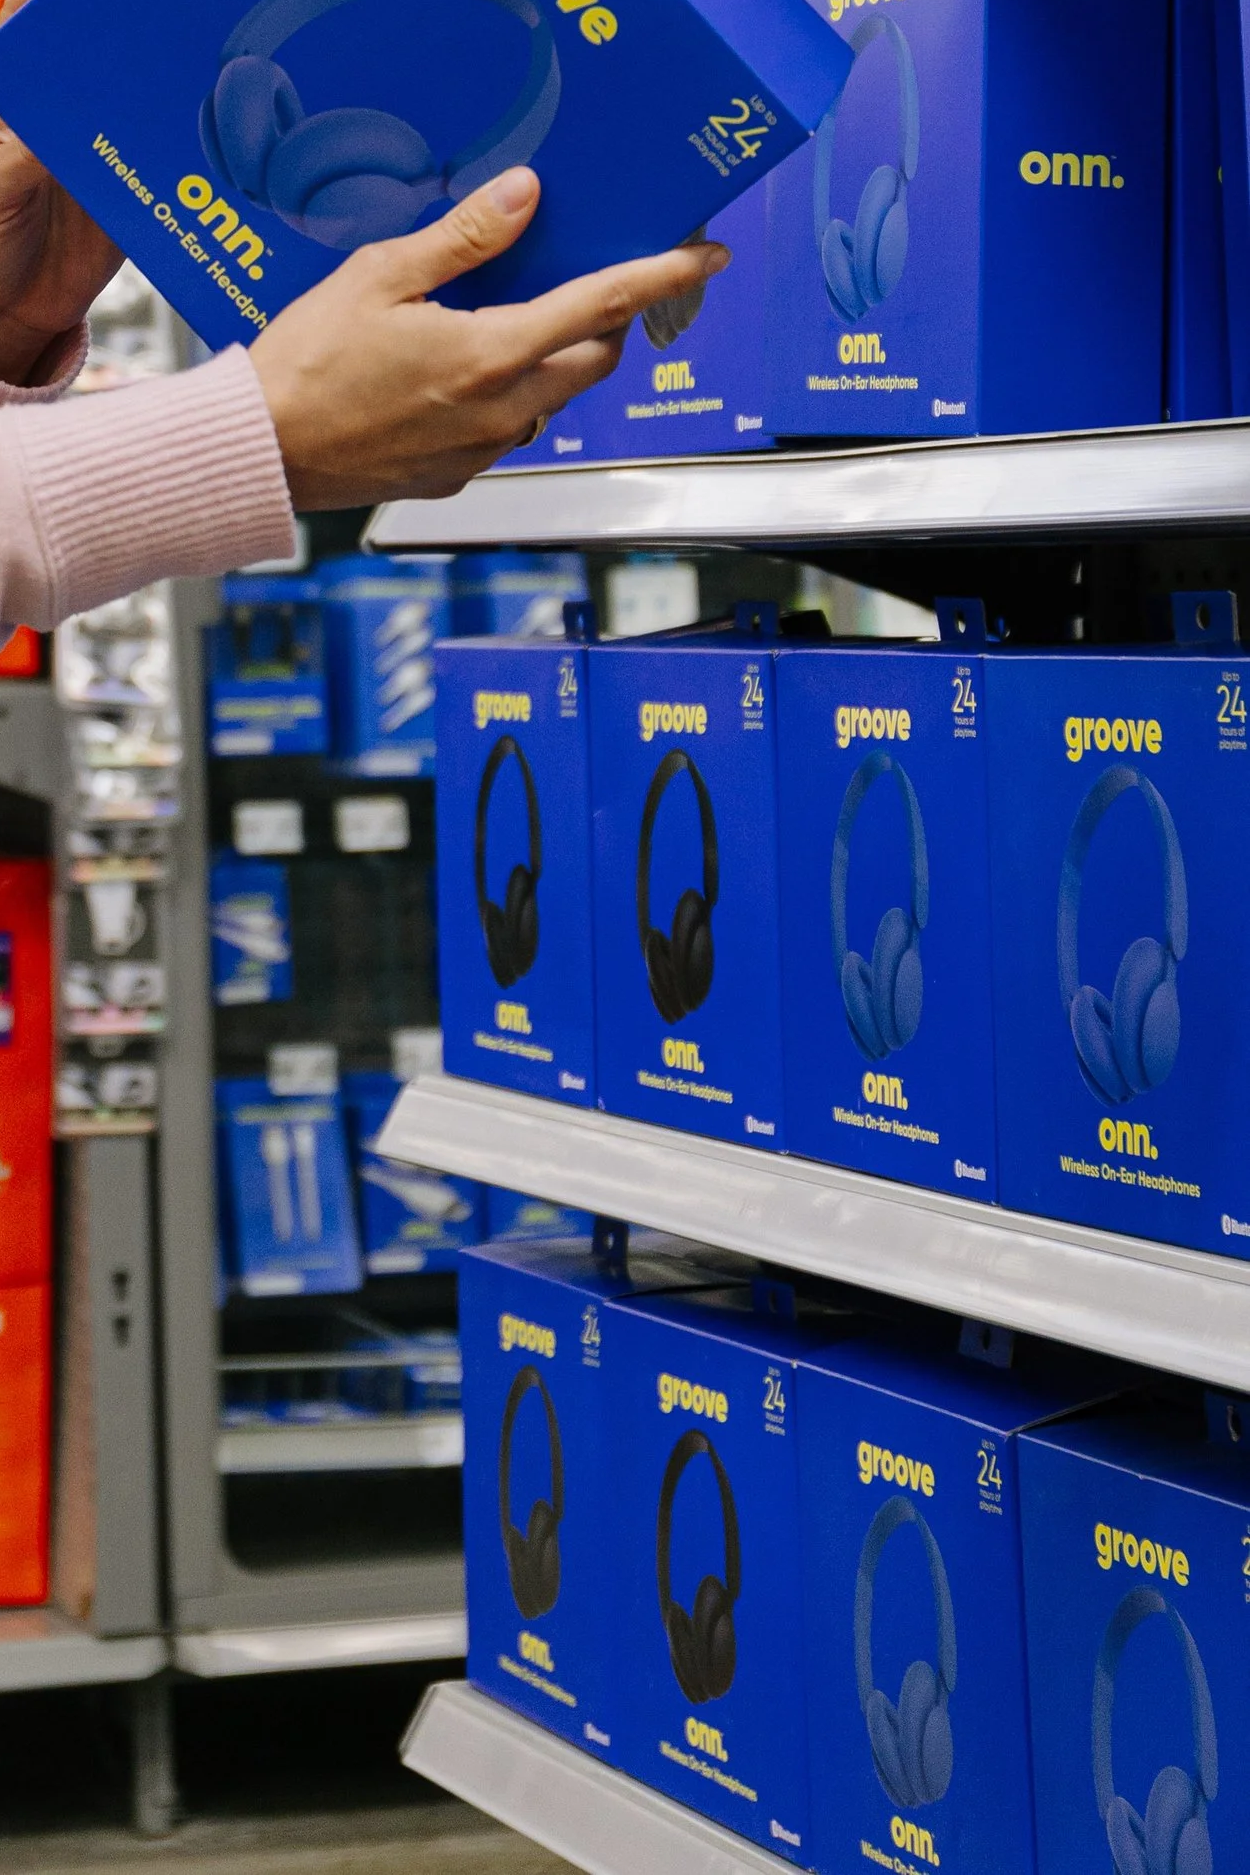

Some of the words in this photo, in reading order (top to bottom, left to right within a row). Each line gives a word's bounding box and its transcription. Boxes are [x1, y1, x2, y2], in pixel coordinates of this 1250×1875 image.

[708, 98, 769, 158] 24
[750, 94, 766, 113] Up
[764, 110, 777, 126] to
[1020, 150, 1124, 189] onn.
[92, 133, 155, 205] Wireless
[153, 202, 210, 263] On-Ear
[206, 260, 269, 330] Headph
[177, 174, 264, 281] onn.
[839, 333, 886, 364] onn.
[653, 360, 695, 392] onn.
[808, 376, 840, 390] Wireless
[840, 376, 869, 390] On-Ear
[870, 375, 918, 392] Headphones
[558, 666, 578, 698] 24
[741, 674, 764, 709] 24
[951, 678, 977, 714] 24
[475, 691, 531, 729] groove
[639, 701, 707, 741] groove
[1216, 684, 1247, 723] 24
[835, 705, 911, 749] groove
[1064, 716, 1163, 762] groove
[662, 1037, 704, 1074] onn.
[862, 1071, 908, 1110] onn.
[833, 1106, 864, 1127] Wireless
[893, 1119, 940, 1145] Headphones
[1098, 1117, 1158, 1160] onn.
[1060, 1155, 1100, 1178] Wireless
[1101, 1163, 1137, 1185] On-Ear
[1138, 1170, 1201, 1198] Headphones
[498, 1313, 556, 1359] groove
[580, 1313, 601, 1347] 24
[657, 1373, 729, 1424] groove
[762, 1376, 786, 1414] 24
[857, 1440, 936, 1498] groove
[976, 1450, 1003, 1491] 24
[1093, 1522, 1190, 1587] groove
[685, 1716, 729, 1763] onn.
[890, 1815, 940, 1867] onn.
